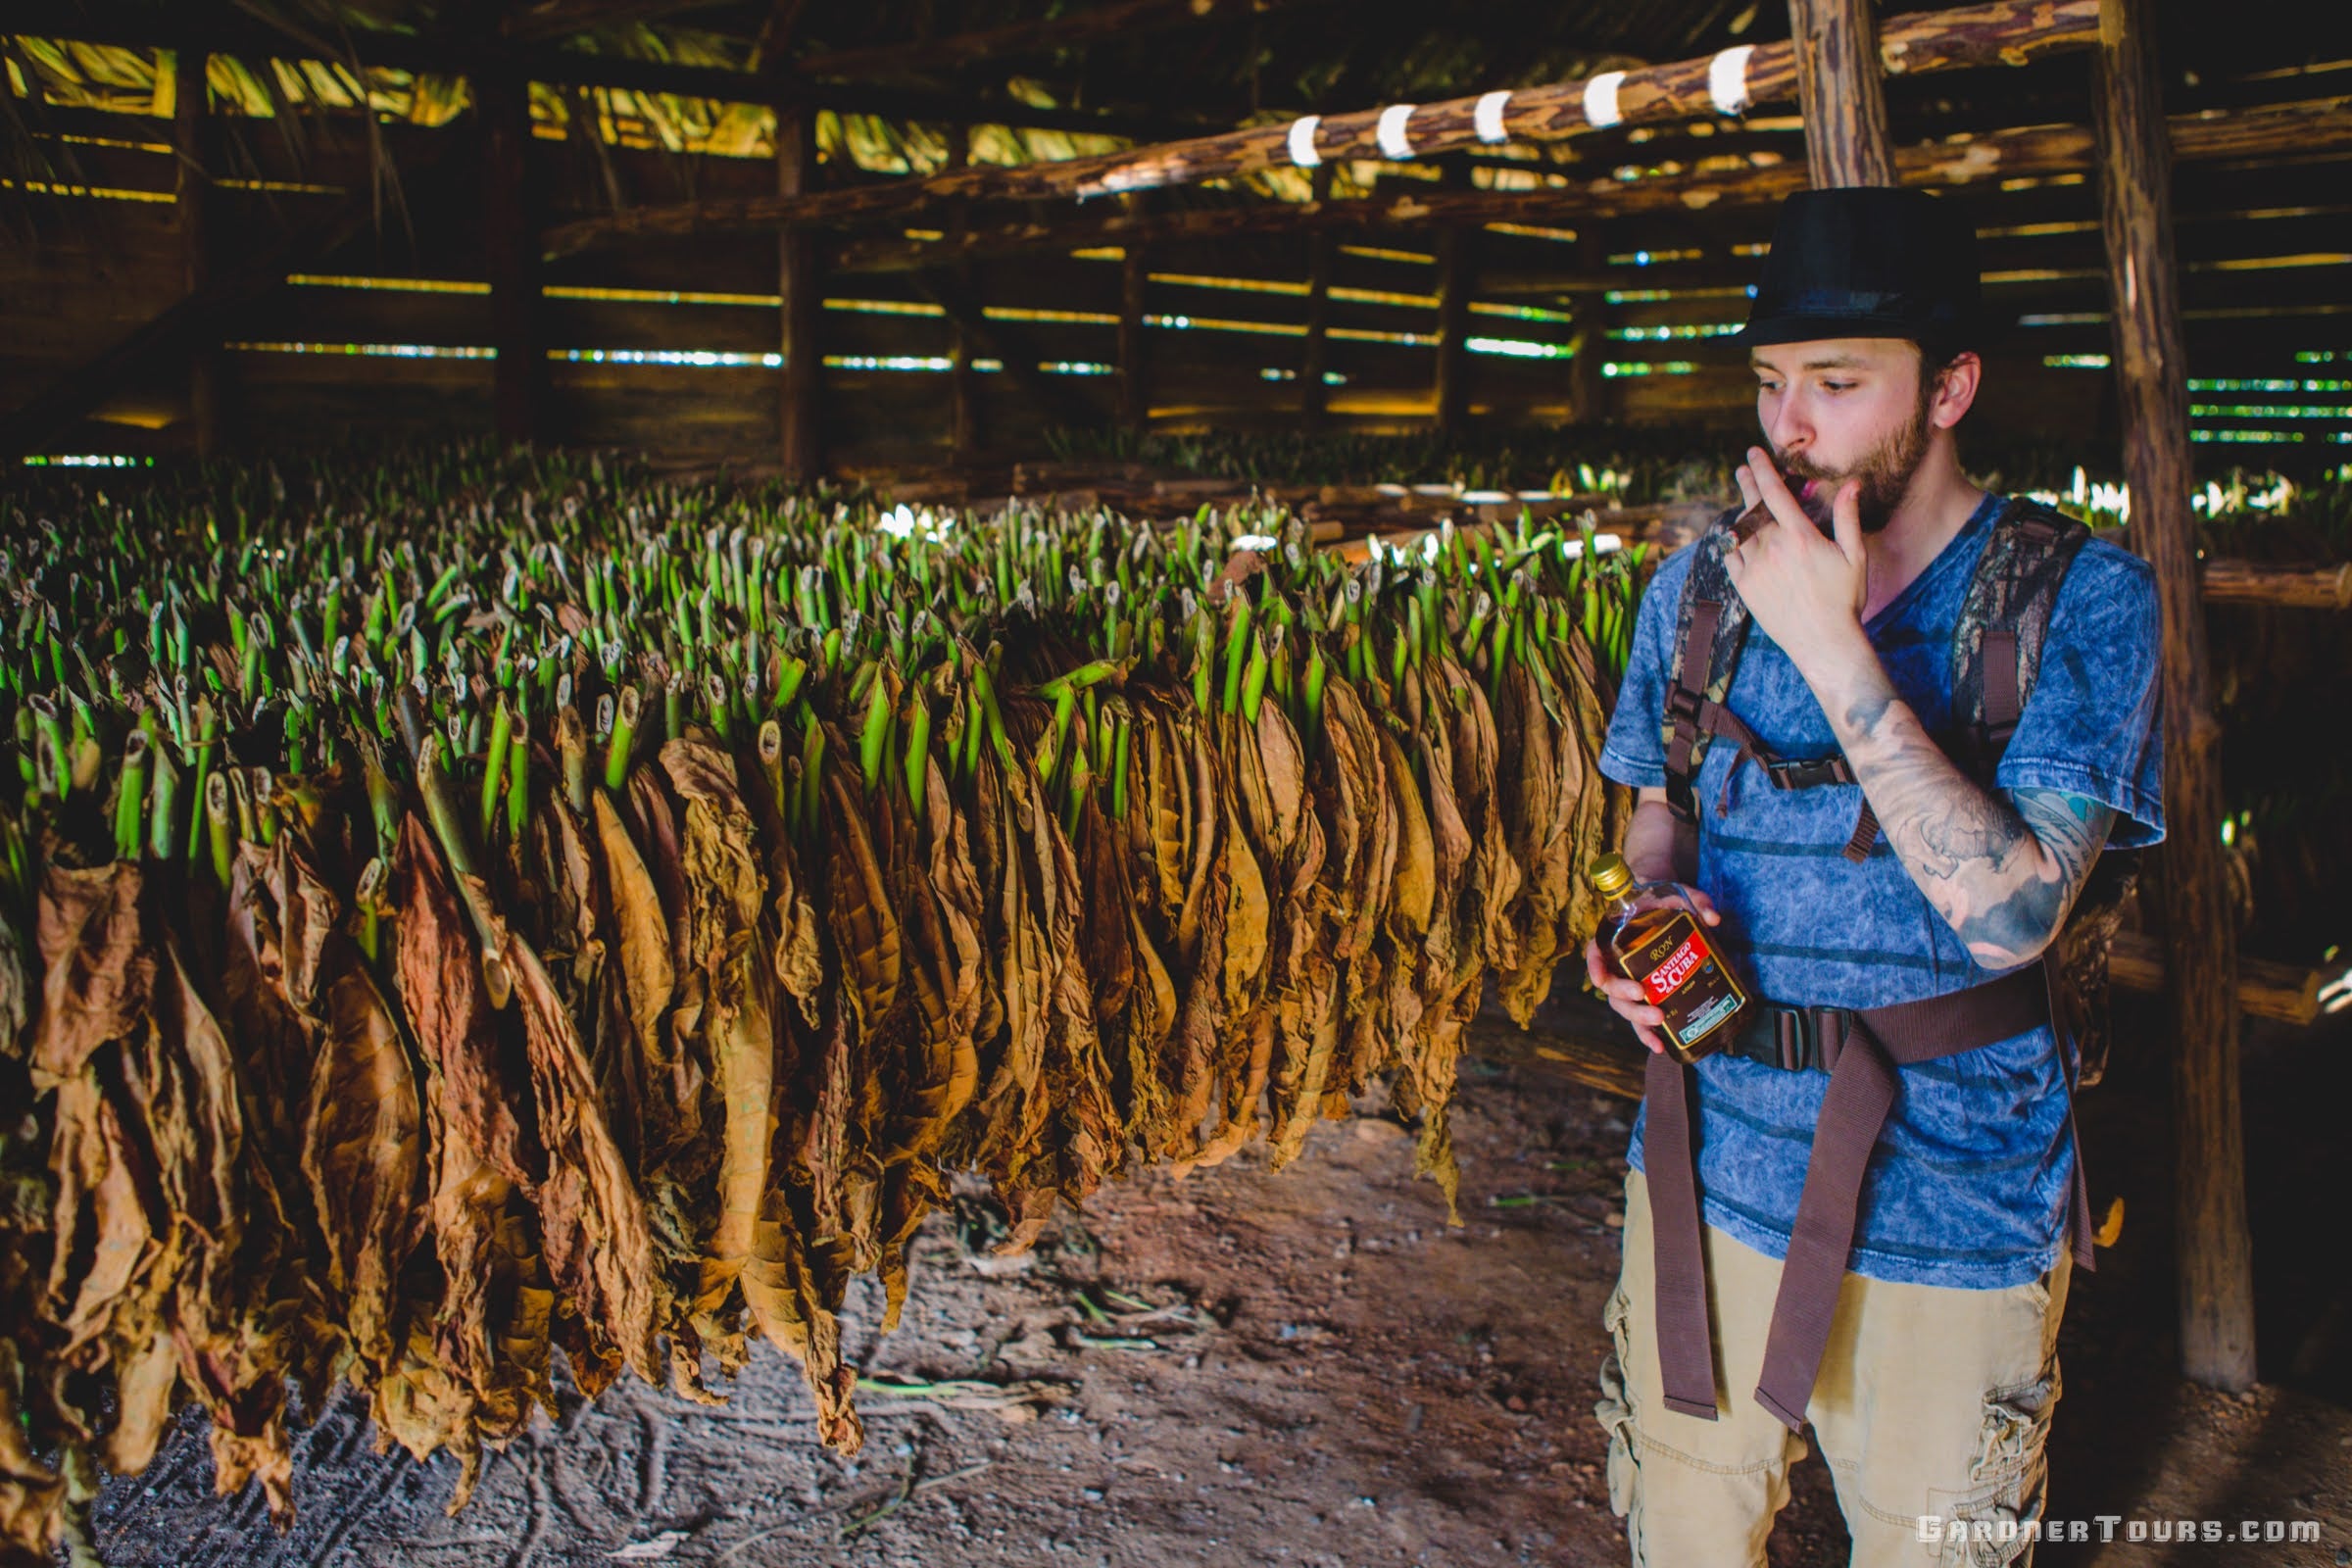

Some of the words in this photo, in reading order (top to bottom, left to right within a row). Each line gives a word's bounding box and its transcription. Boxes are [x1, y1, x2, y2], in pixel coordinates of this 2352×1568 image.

[1650, 936, 1673, 960] RON
[1650, 942, 1691, 993] SANTIAGO
[1667, 951, 1698, 987] CUBA
